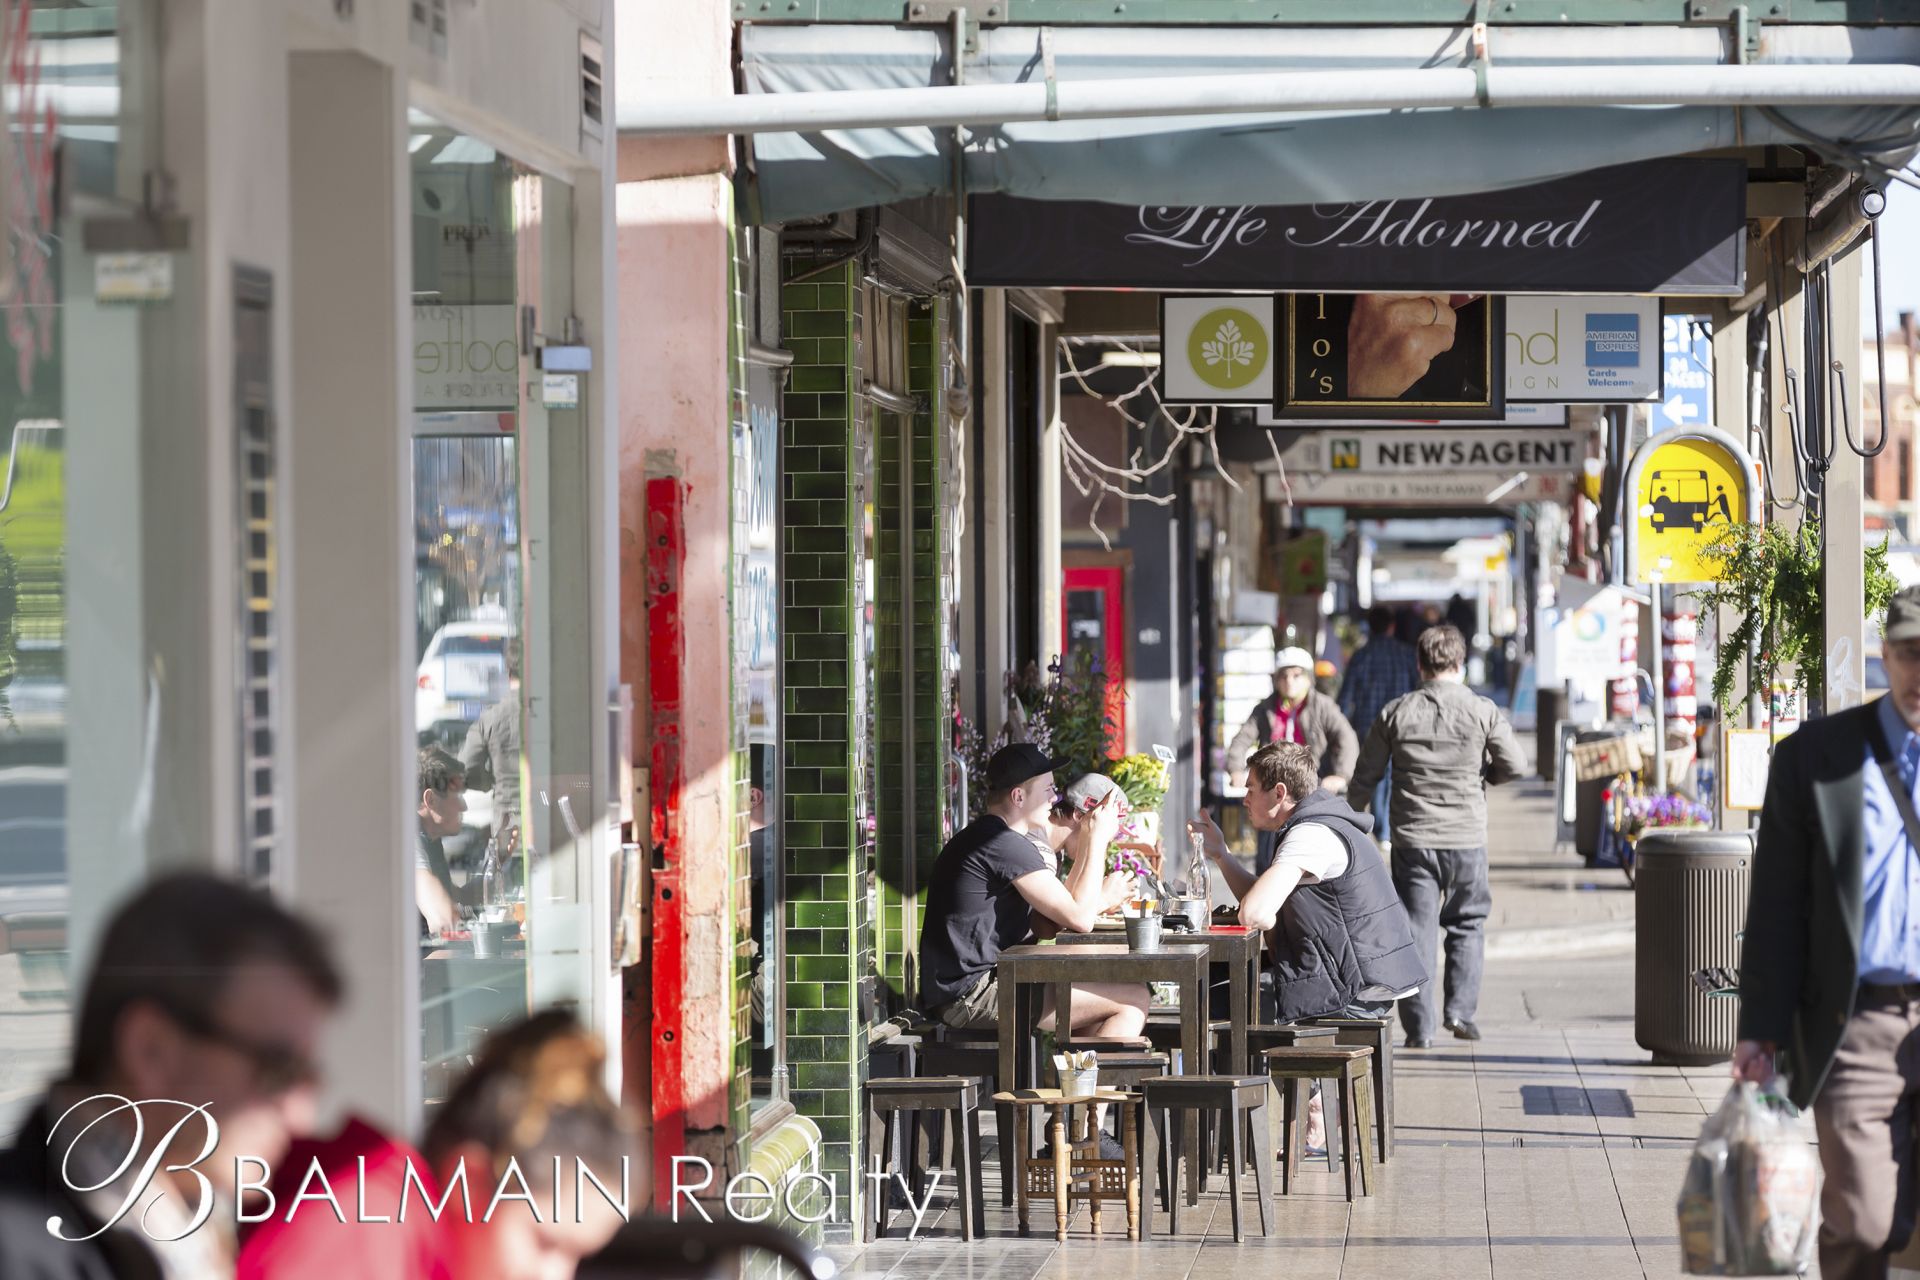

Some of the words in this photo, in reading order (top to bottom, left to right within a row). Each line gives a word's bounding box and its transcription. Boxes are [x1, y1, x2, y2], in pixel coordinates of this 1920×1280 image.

[1285, 198, 1603, 248] Adorned
[1586, 331, 1636, 341] AMERICAN
[1596, 342, 1639, 352] EXPRESS
[1588, 368, 1617, 377] Cards
[1378, 440, 1576, 466] NEWSAGENT
